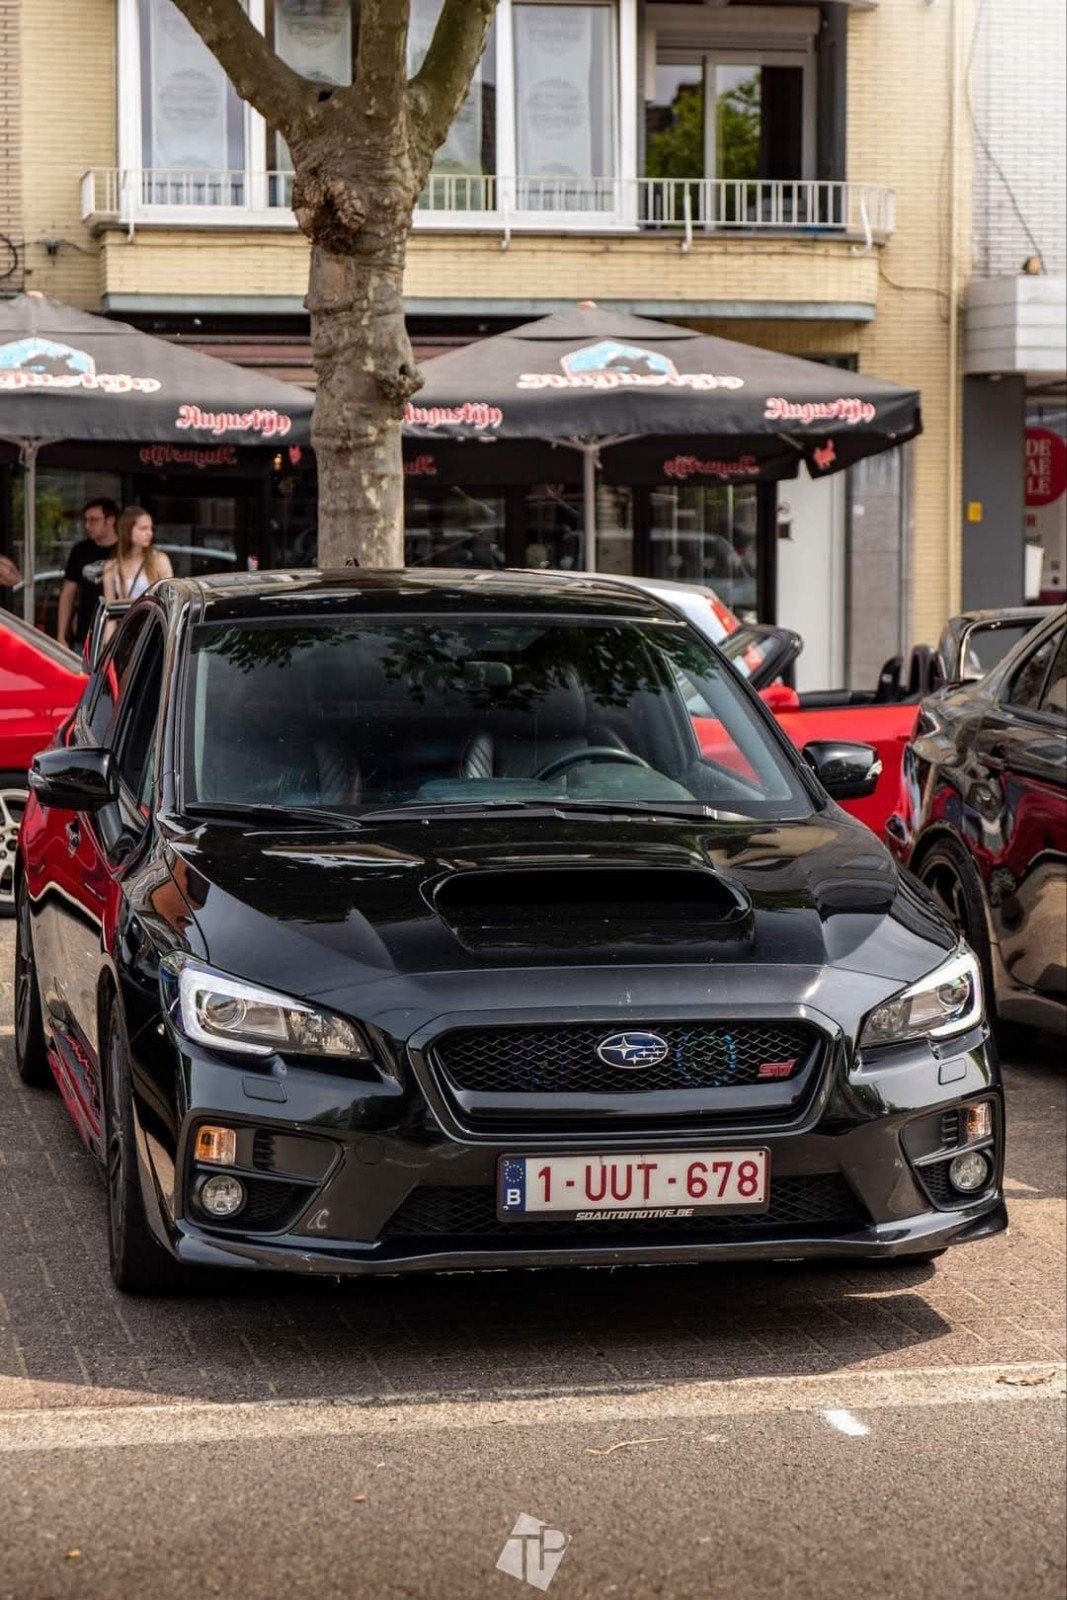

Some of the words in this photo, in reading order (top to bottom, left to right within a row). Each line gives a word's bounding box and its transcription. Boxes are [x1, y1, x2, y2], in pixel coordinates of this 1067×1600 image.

[175, 404, 292, 437] Augustijn
[763, 397, 876, 425] Augustijn
[506, 1188, 521, 1205] B
